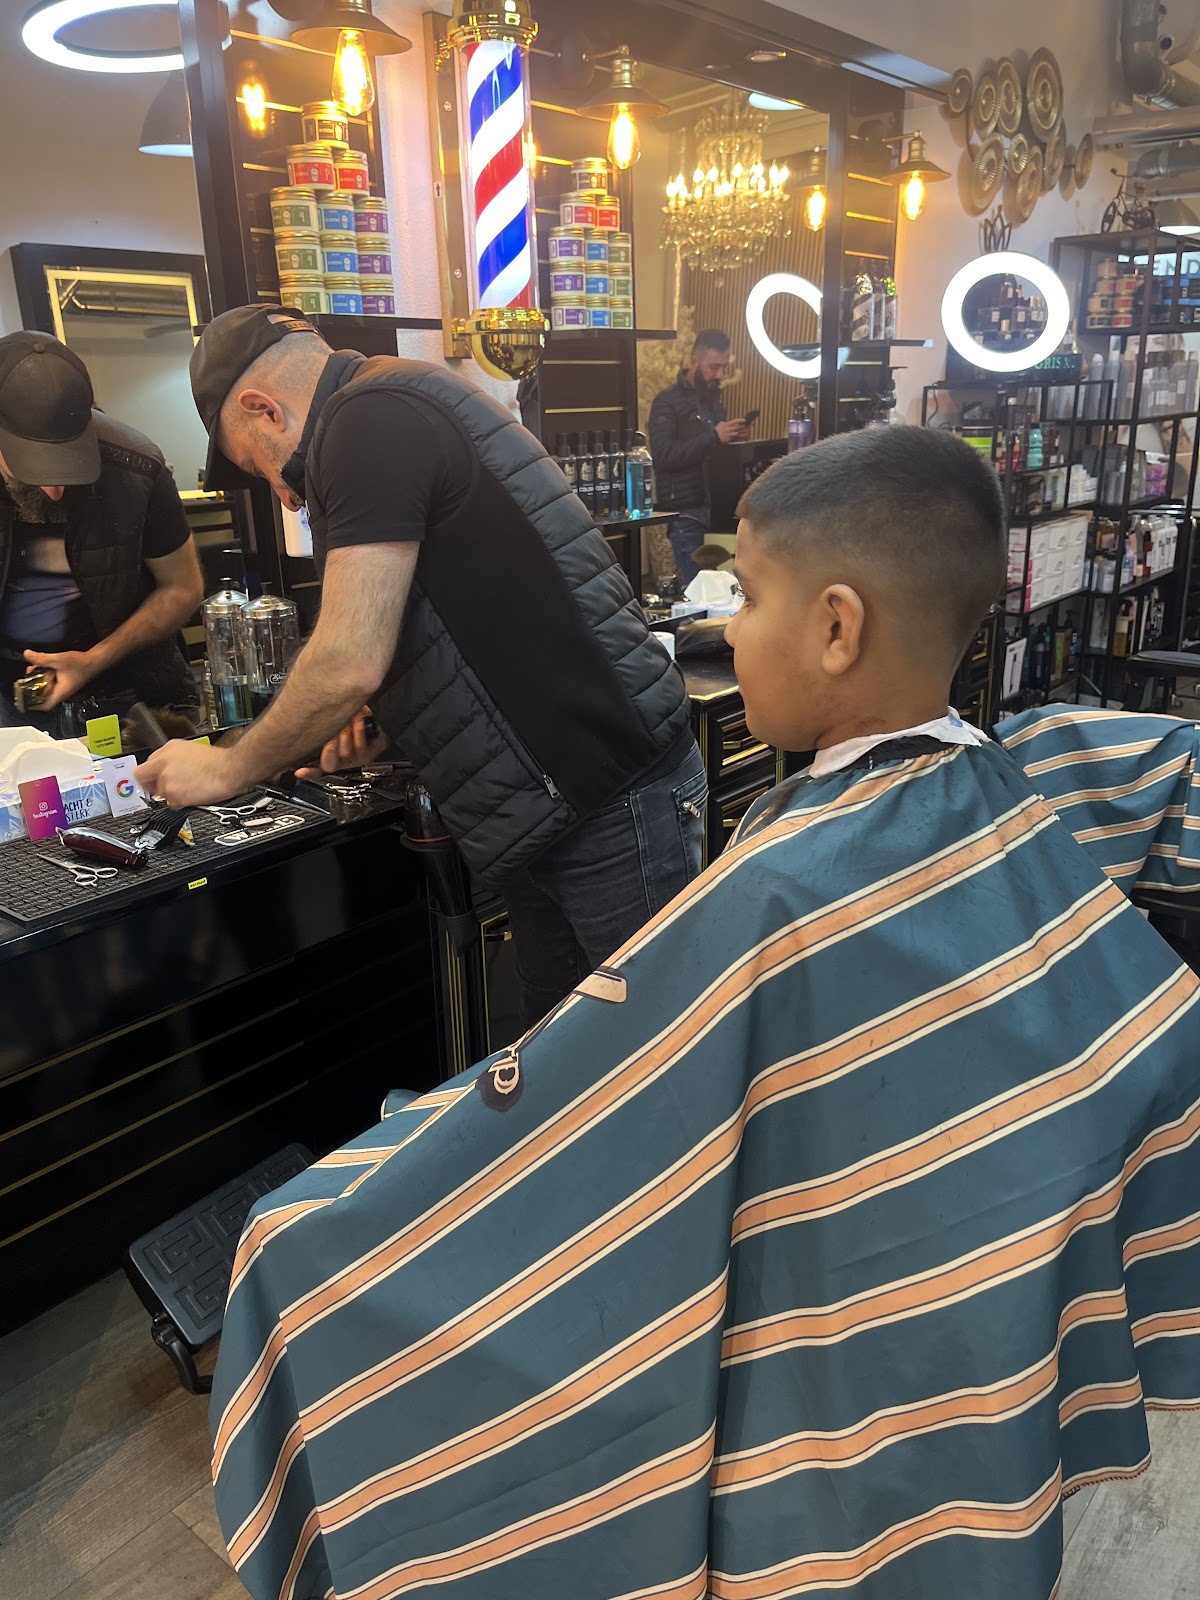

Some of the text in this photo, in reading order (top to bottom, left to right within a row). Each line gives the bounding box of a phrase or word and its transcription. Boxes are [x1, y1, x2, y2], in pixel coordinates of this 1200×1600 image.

[64, 798, 93, 812] ACHT &
[32, 808, 58, 820] Instagram
[65, 808, 91, 822] STERK
